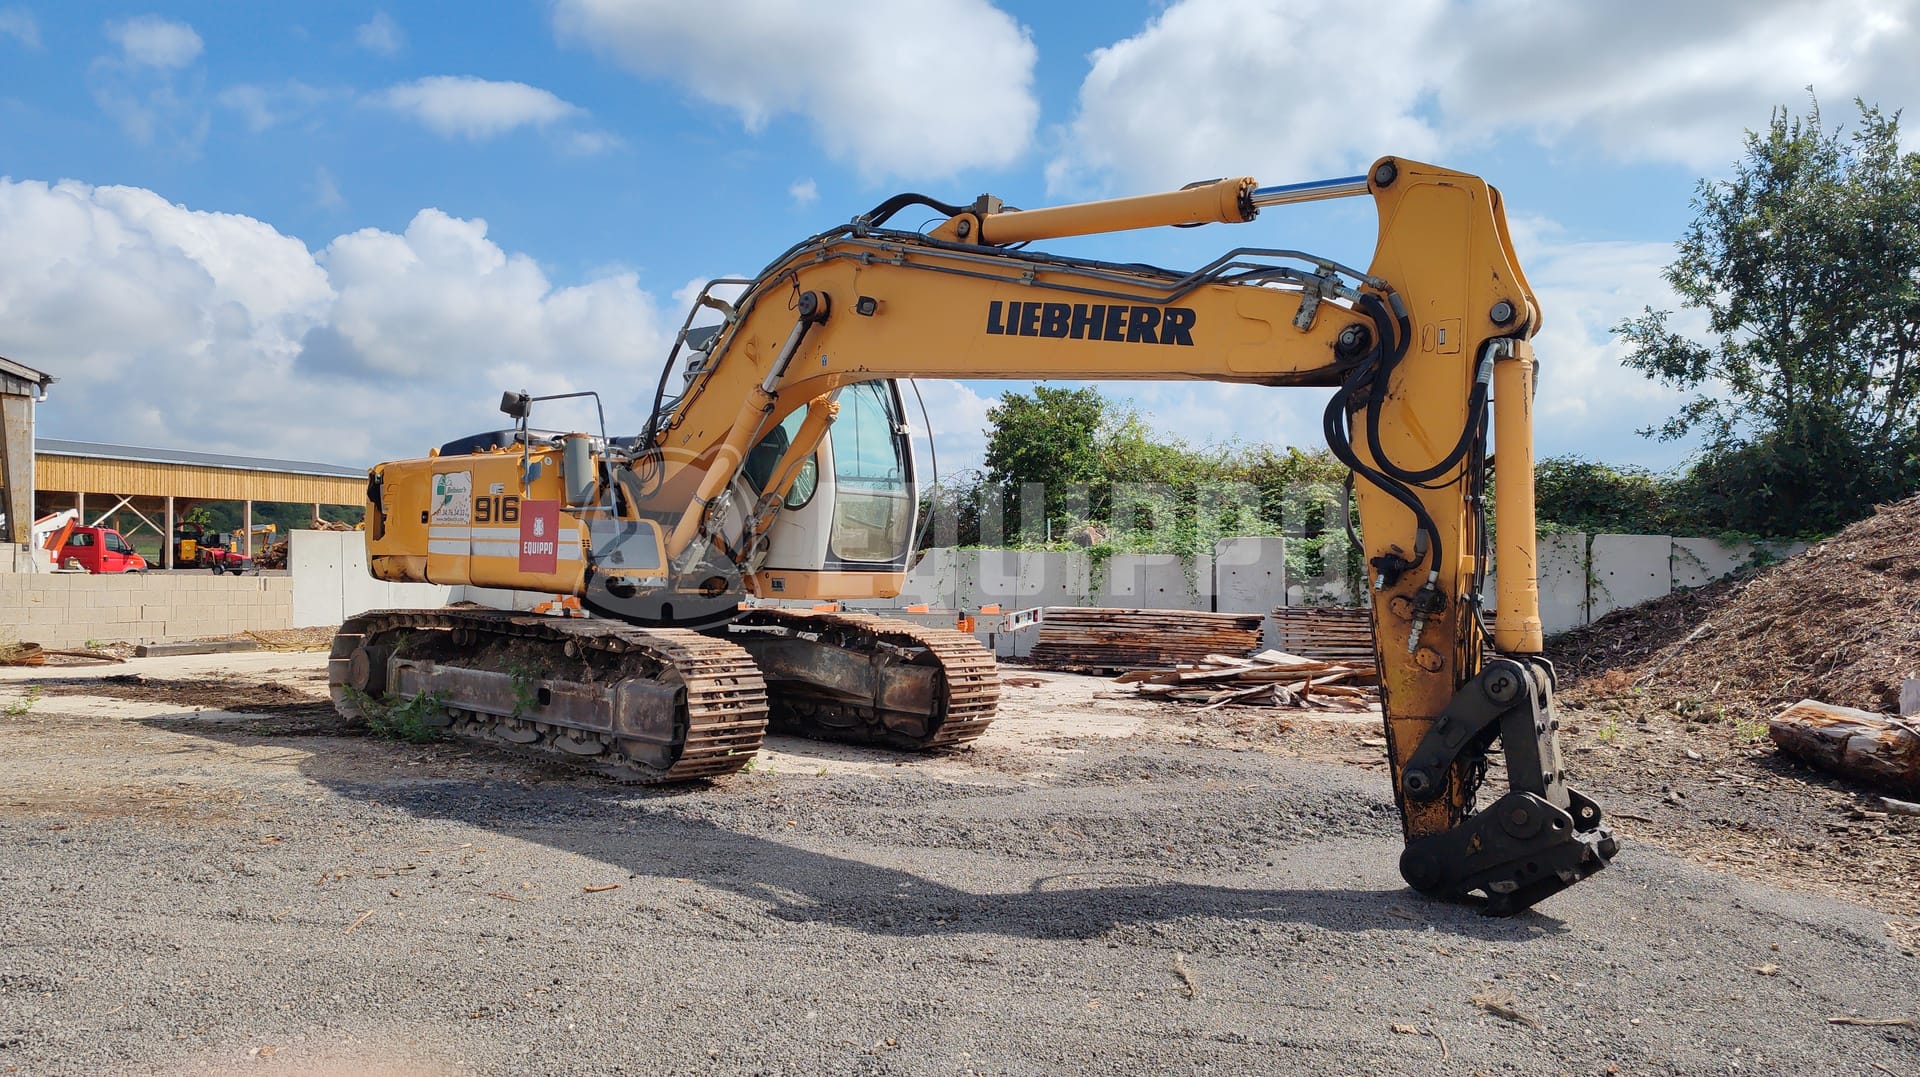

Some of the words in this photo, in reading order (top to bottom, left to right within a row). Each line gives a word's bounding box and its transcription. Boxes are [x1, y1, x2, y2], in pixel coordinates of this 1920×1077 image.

[986, 300, 1196, 346] LIEBHERR
[475, 497, 520, 522] 916
[523, 541, 553, 556] EQUIPPO
